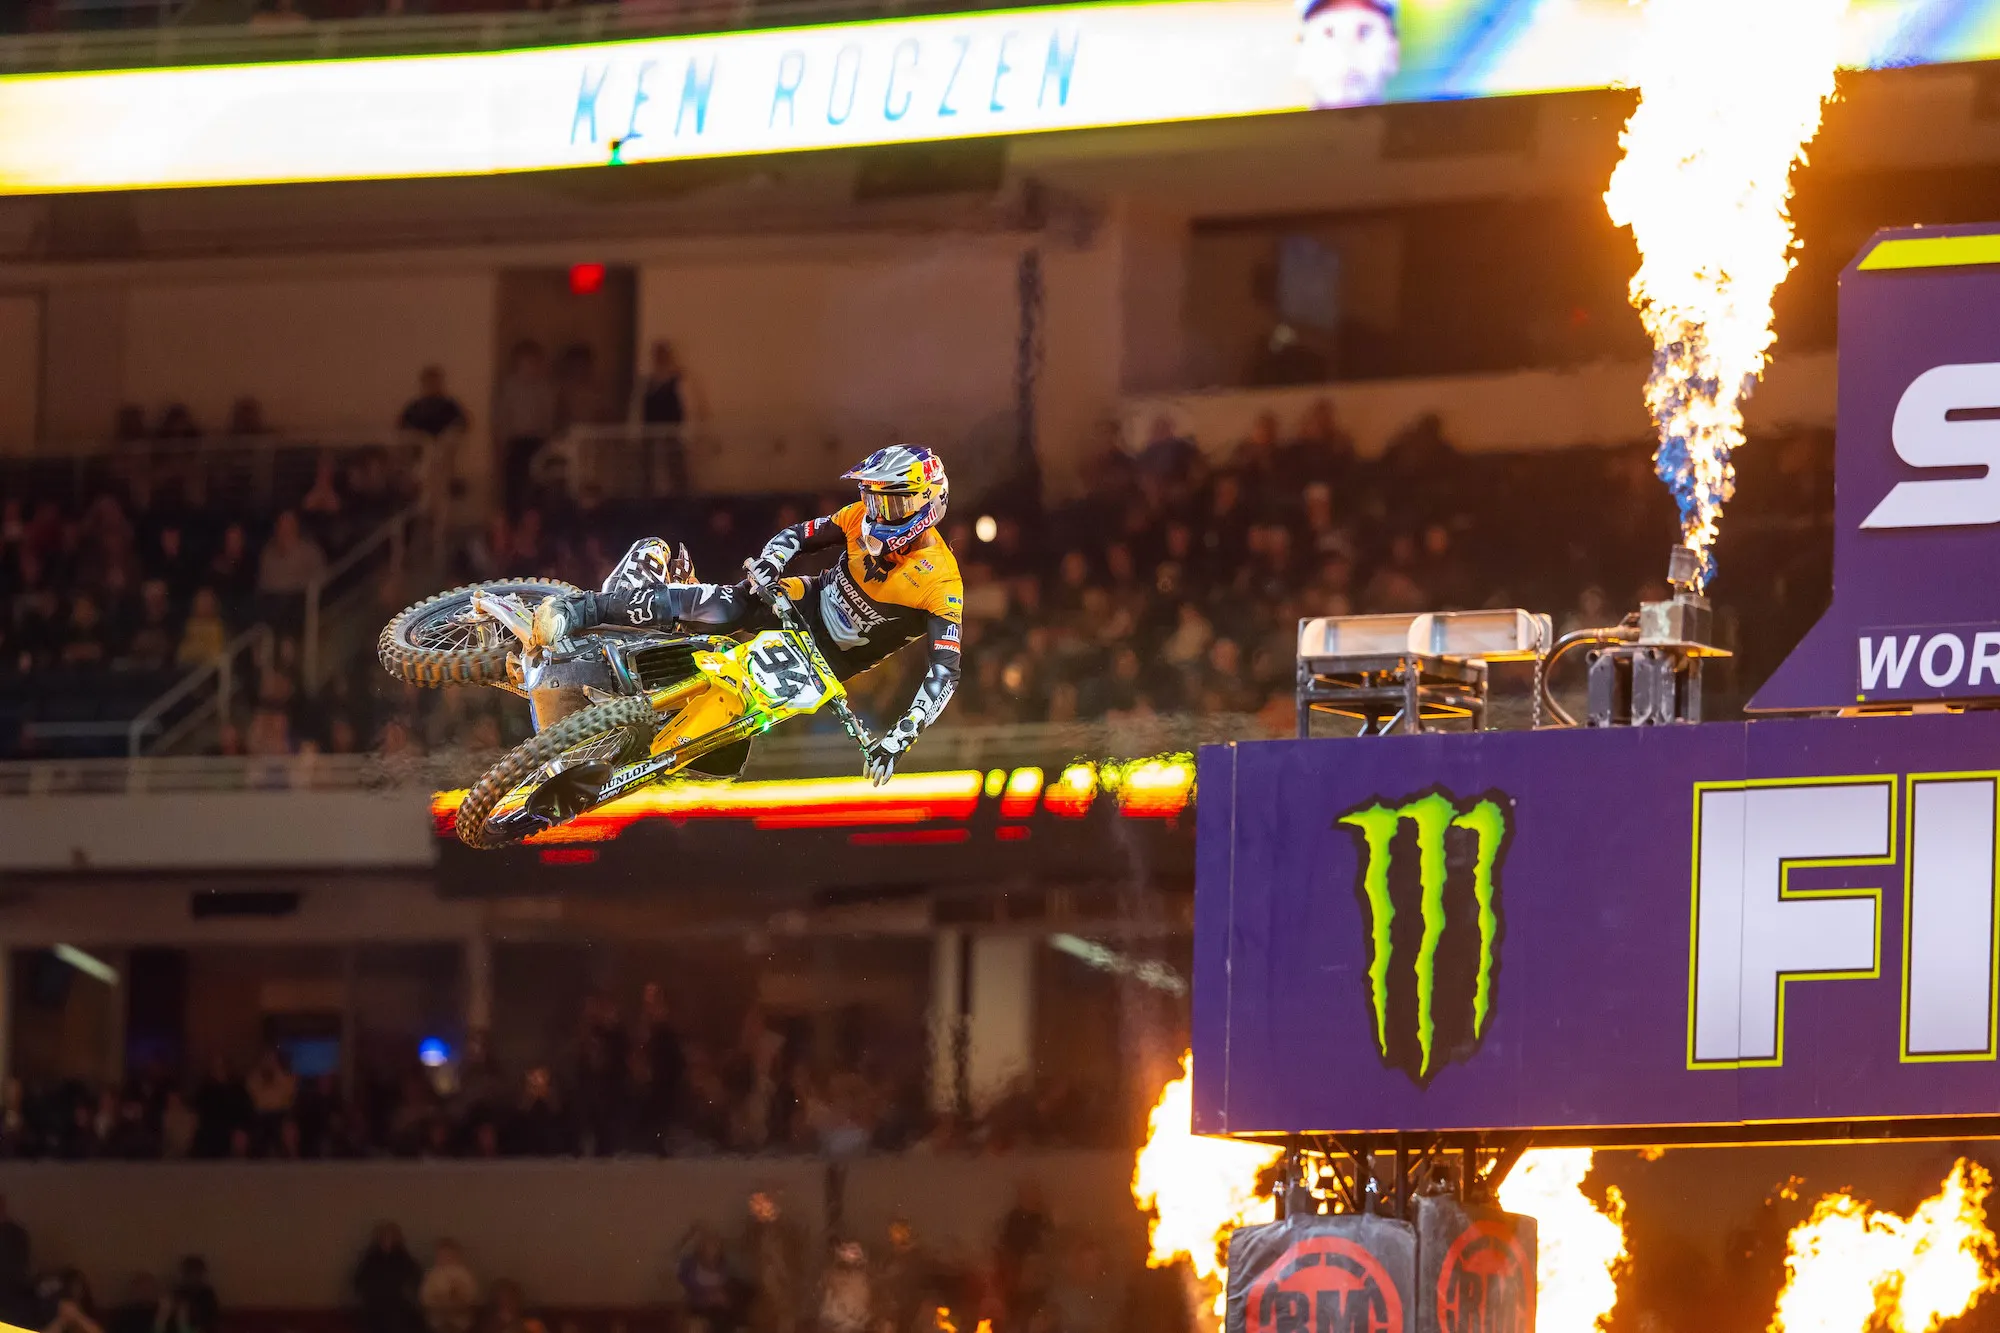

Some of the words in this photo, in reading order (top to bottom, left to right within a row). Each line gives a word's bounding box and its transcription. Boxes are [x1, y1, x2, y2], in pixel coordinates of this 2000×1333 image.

[570, 51, 718, 145] KEN
[768, 27, 1080, 129] ROCZEN
[835, 565, 887, 625] PROGRESSIVE
[749, 645, 812, 698] 94
[924, 680, 954, 723] ROGRESSIVE
[1687, 770, 2000, 1070] FI
